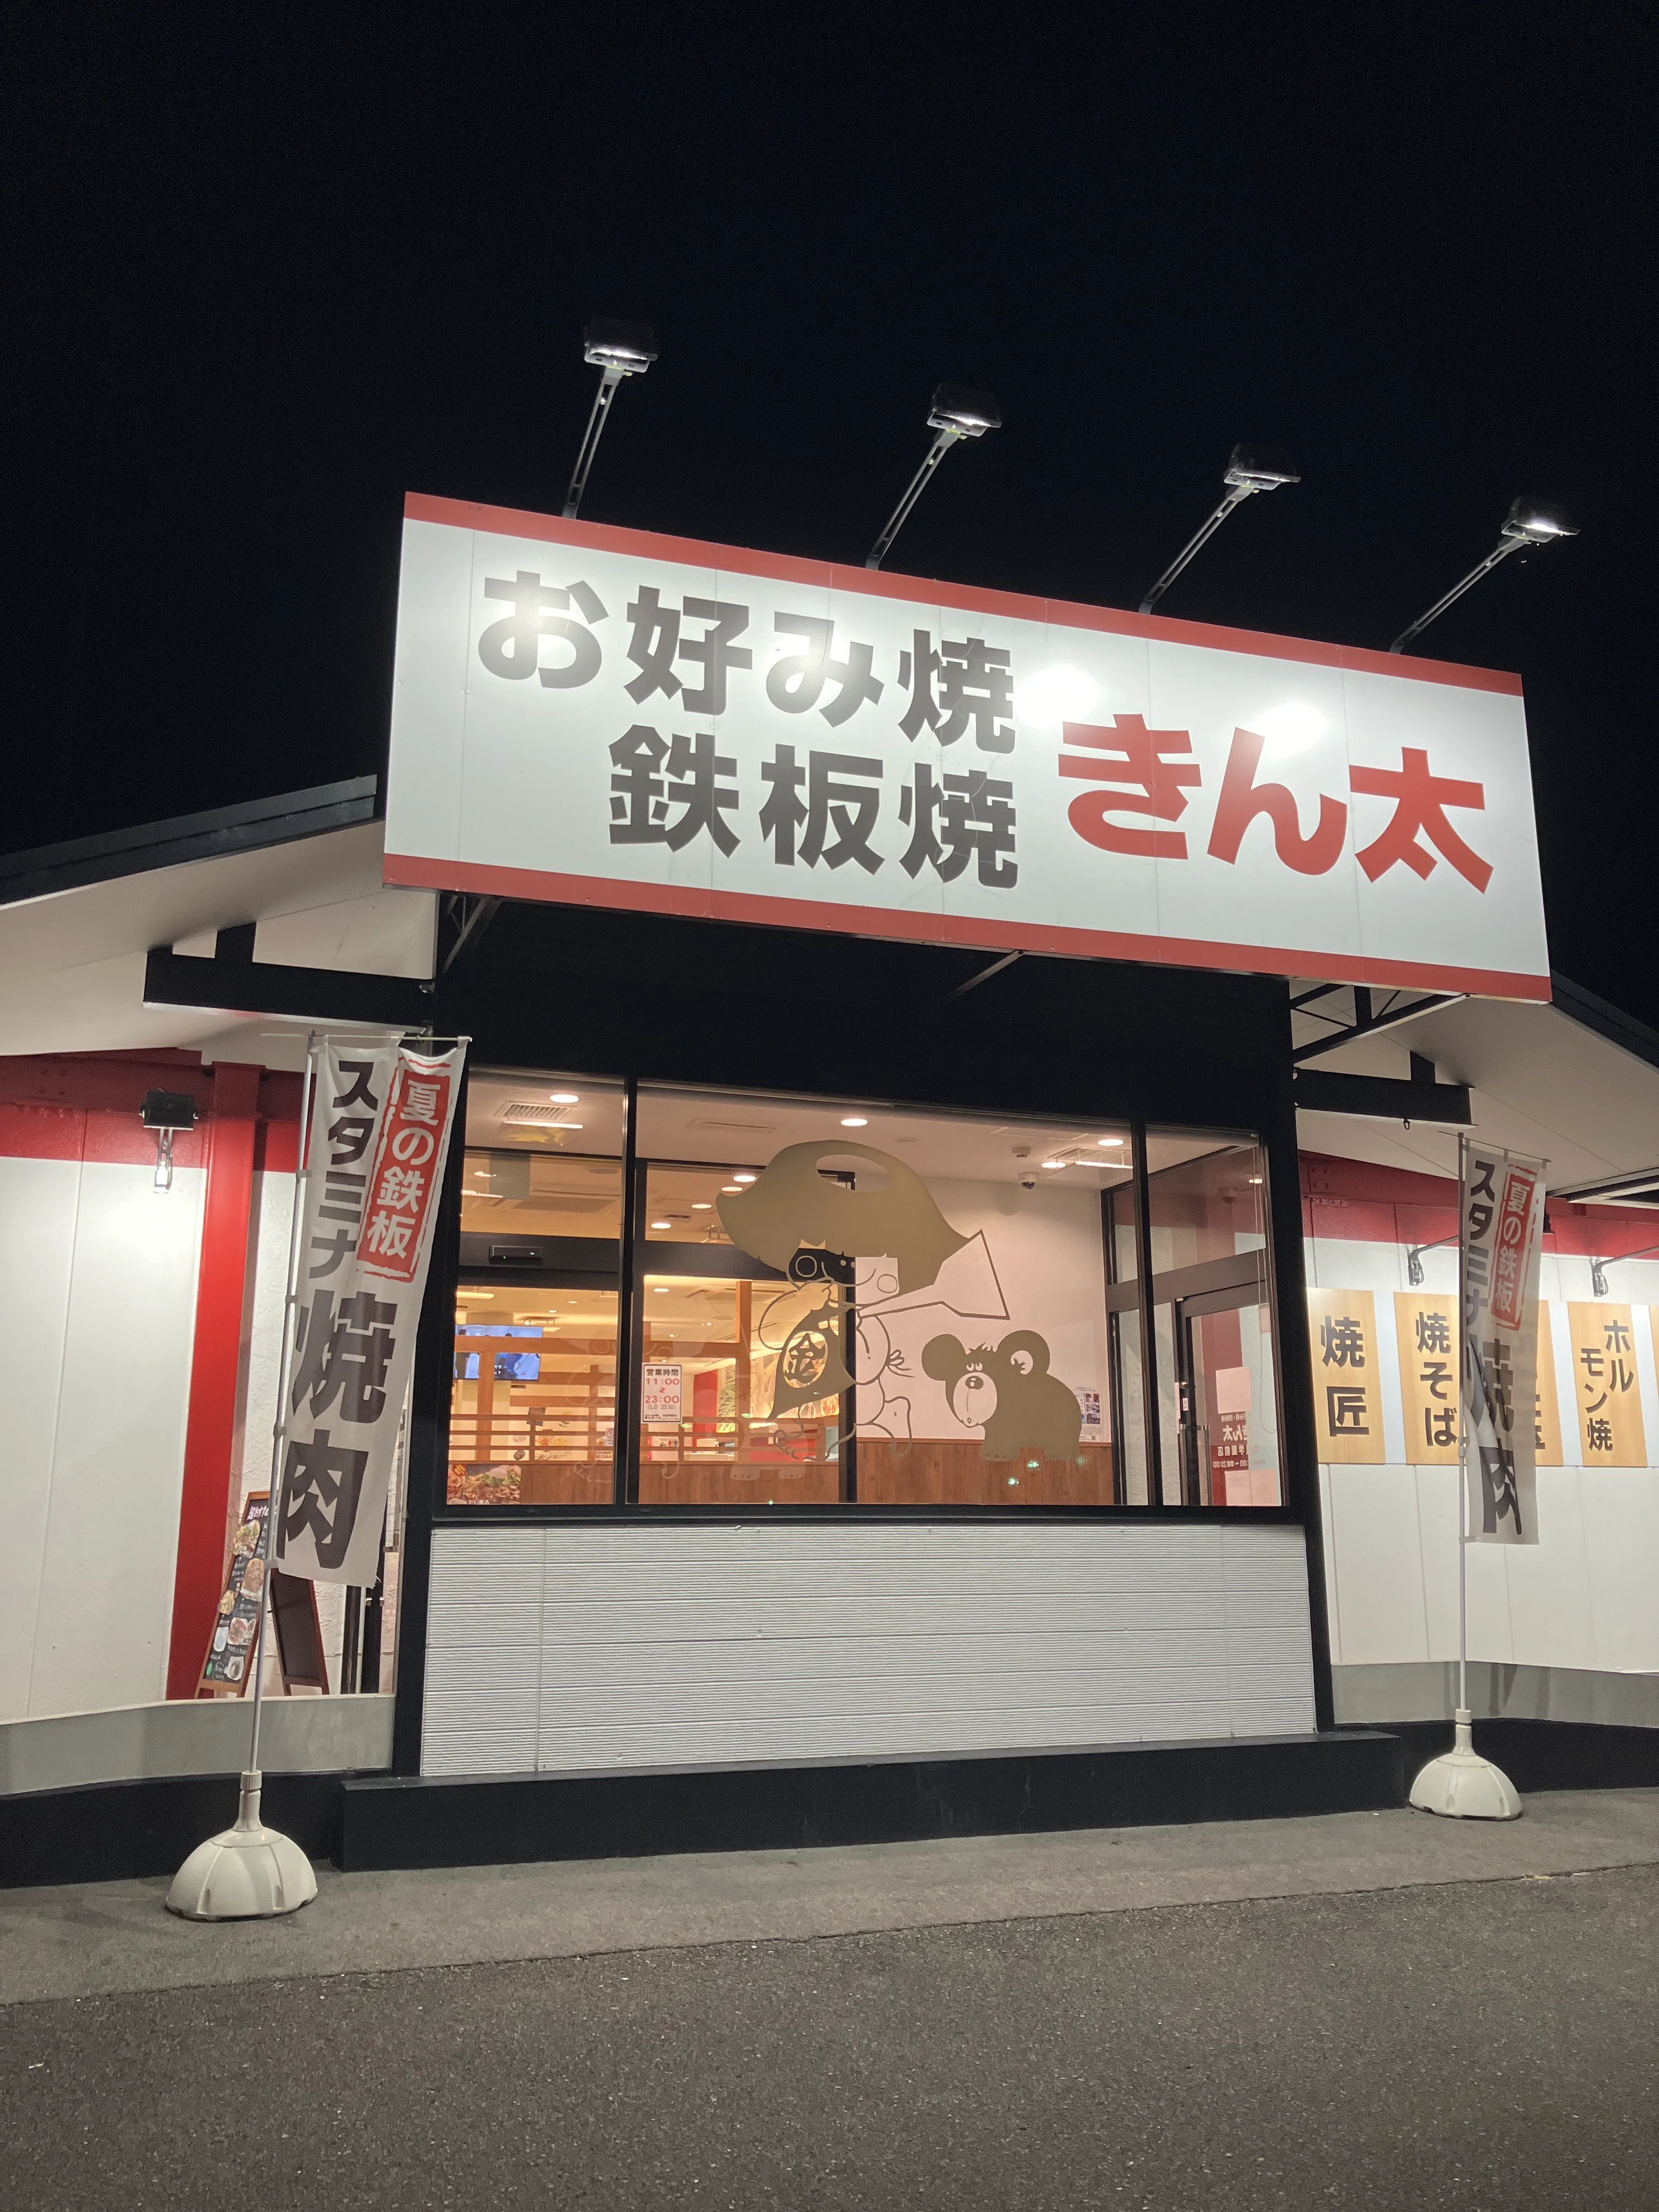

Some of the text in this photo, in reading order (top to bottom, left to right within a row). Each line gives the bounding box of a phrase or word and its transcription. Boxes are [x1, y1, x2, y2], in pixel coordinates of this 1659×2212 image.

[478, 571, 1016, 754] お好み焼
[609, 724, 1018, 889] 鉄板焼
[1058, 713, 1494, 895] きん太
[367, 1080, 441, 1260] 夏の鉄板
[1497, 1181, 1531, 1313] 夏の鉄板
[276, 1060, 399, 1570] スタミナ焼肉
[1321, 1315, 1369, 1437] 焼匠
[1415, 1311, 1458, 1447] 焼そば
[645, 1395, 680, 1403] 23:00
